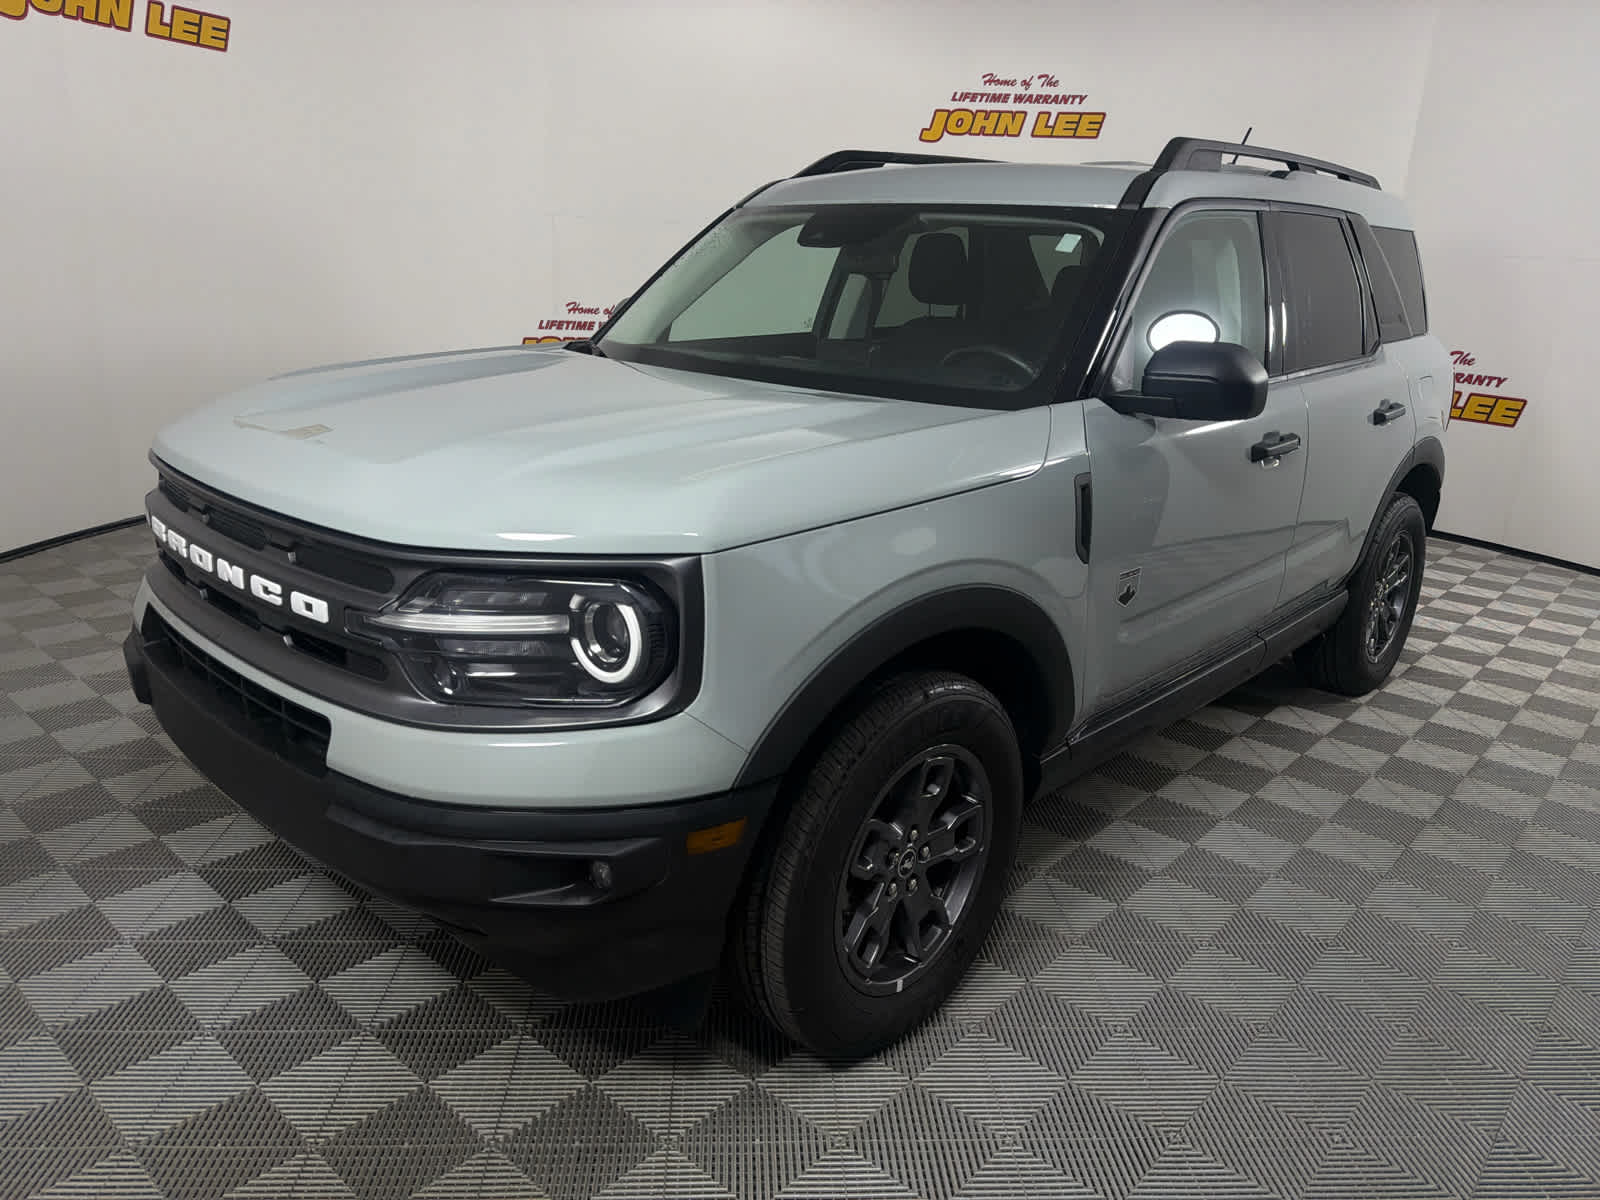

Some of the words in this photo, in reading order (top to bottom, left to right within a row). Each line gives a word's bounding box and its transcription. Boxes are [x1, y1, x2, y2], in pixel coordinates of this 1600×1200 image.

[145, 1, 231, 52] LEE
[982, 73, 1018, 87] Home
[1020, 75, 1034, 91] of
[1037, 74, 1060, 88] The
[951, 91, 1011, 104] LIFETIME
[1013, 94, 1089, 105] WARRANTY
[919, 108, 1028, 143] JOHN
[1031, 111, 1106, 139] LEE
[565, 301, 600, 315] Home
[537, 319, 596, 331] LIFETIME
[1450, 350, 1476, 366] The
[1454, 372, 1508, 388] RANTY
[1449, 390, 1528, 428] LEE
[151, 515, 329, 624] BRONCO
